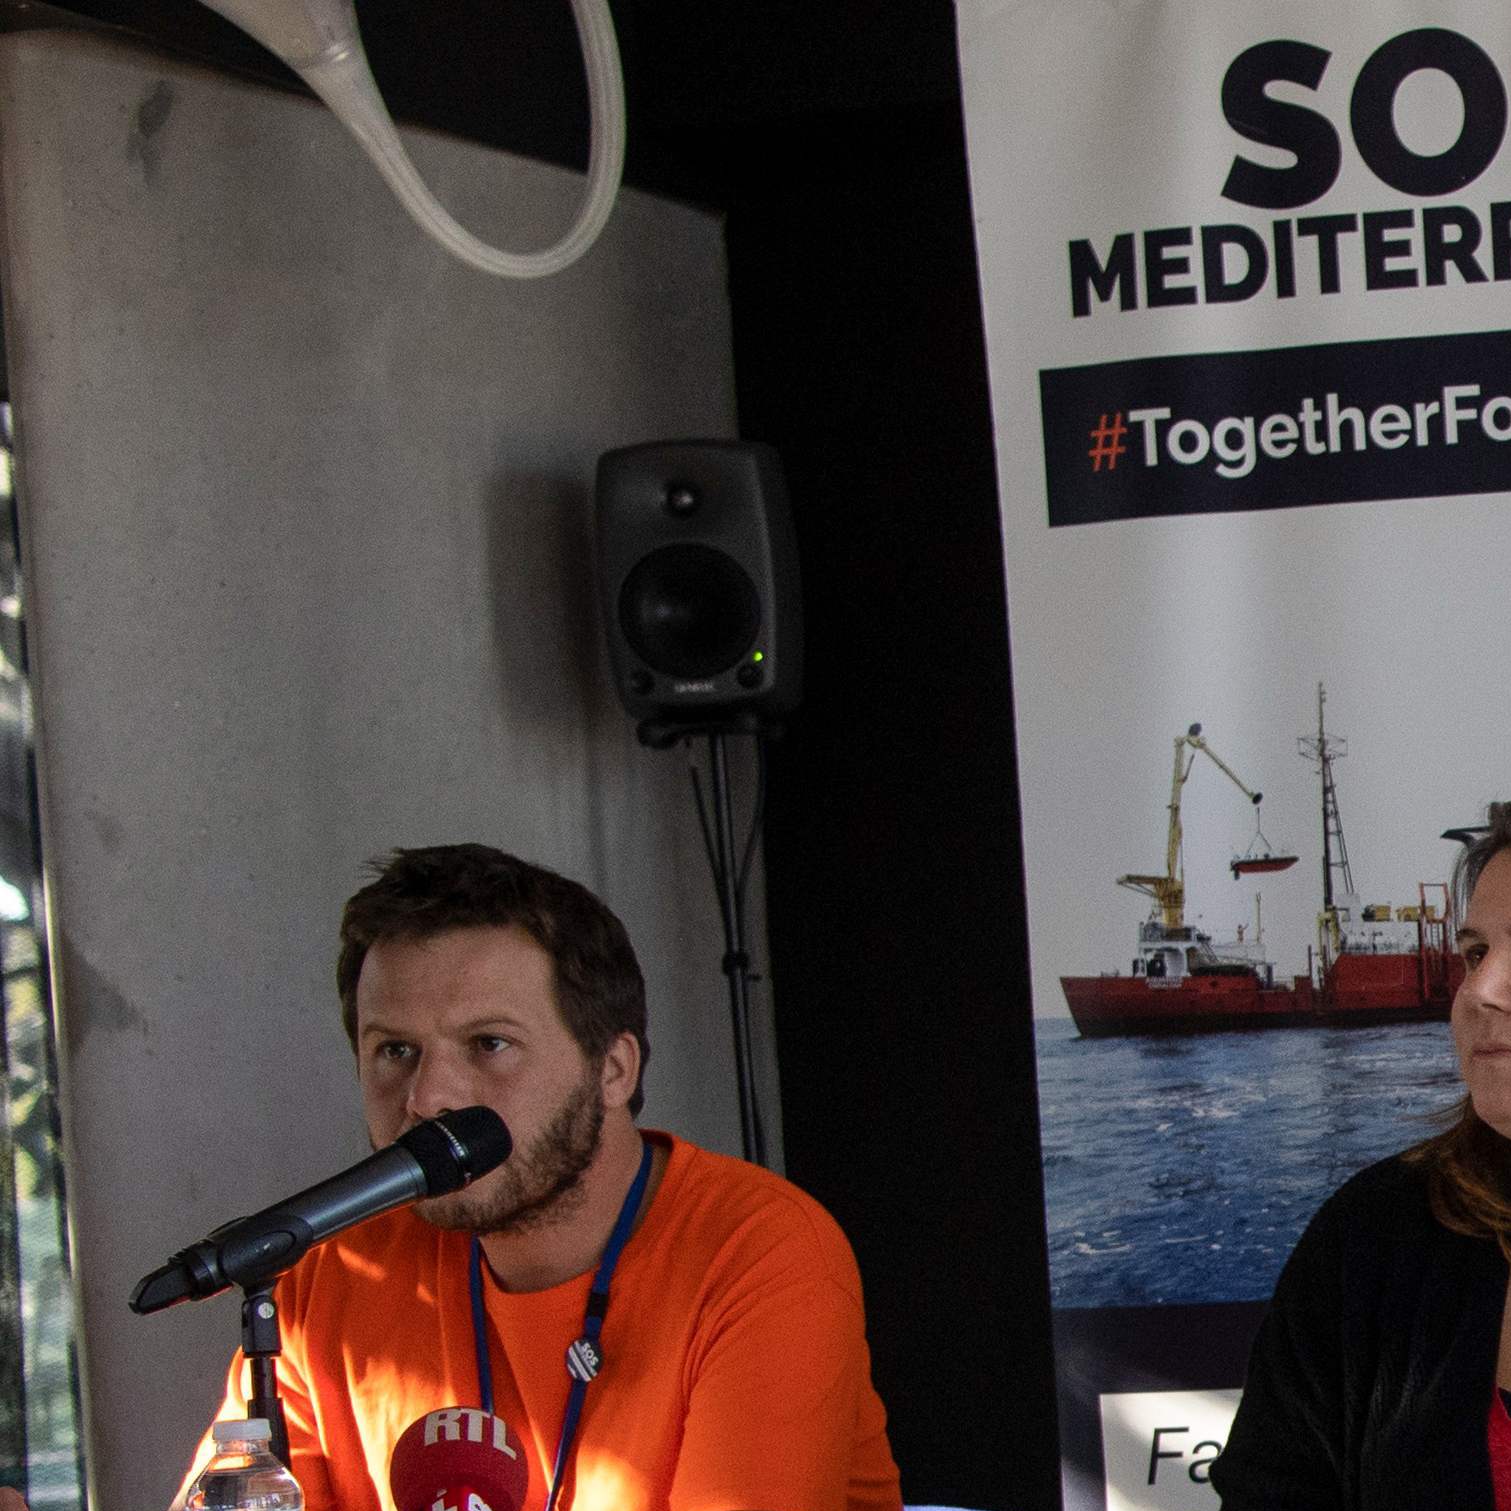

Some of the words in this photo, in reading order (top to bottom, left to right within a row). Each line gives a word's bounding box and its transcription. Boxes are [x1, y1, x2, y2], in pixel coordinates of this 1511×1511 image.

[582, 1342, 599, 1367] SOS
[424, 1408, 517, 1461] RTL
[1147, 1425, 1223, 1486] Fa
